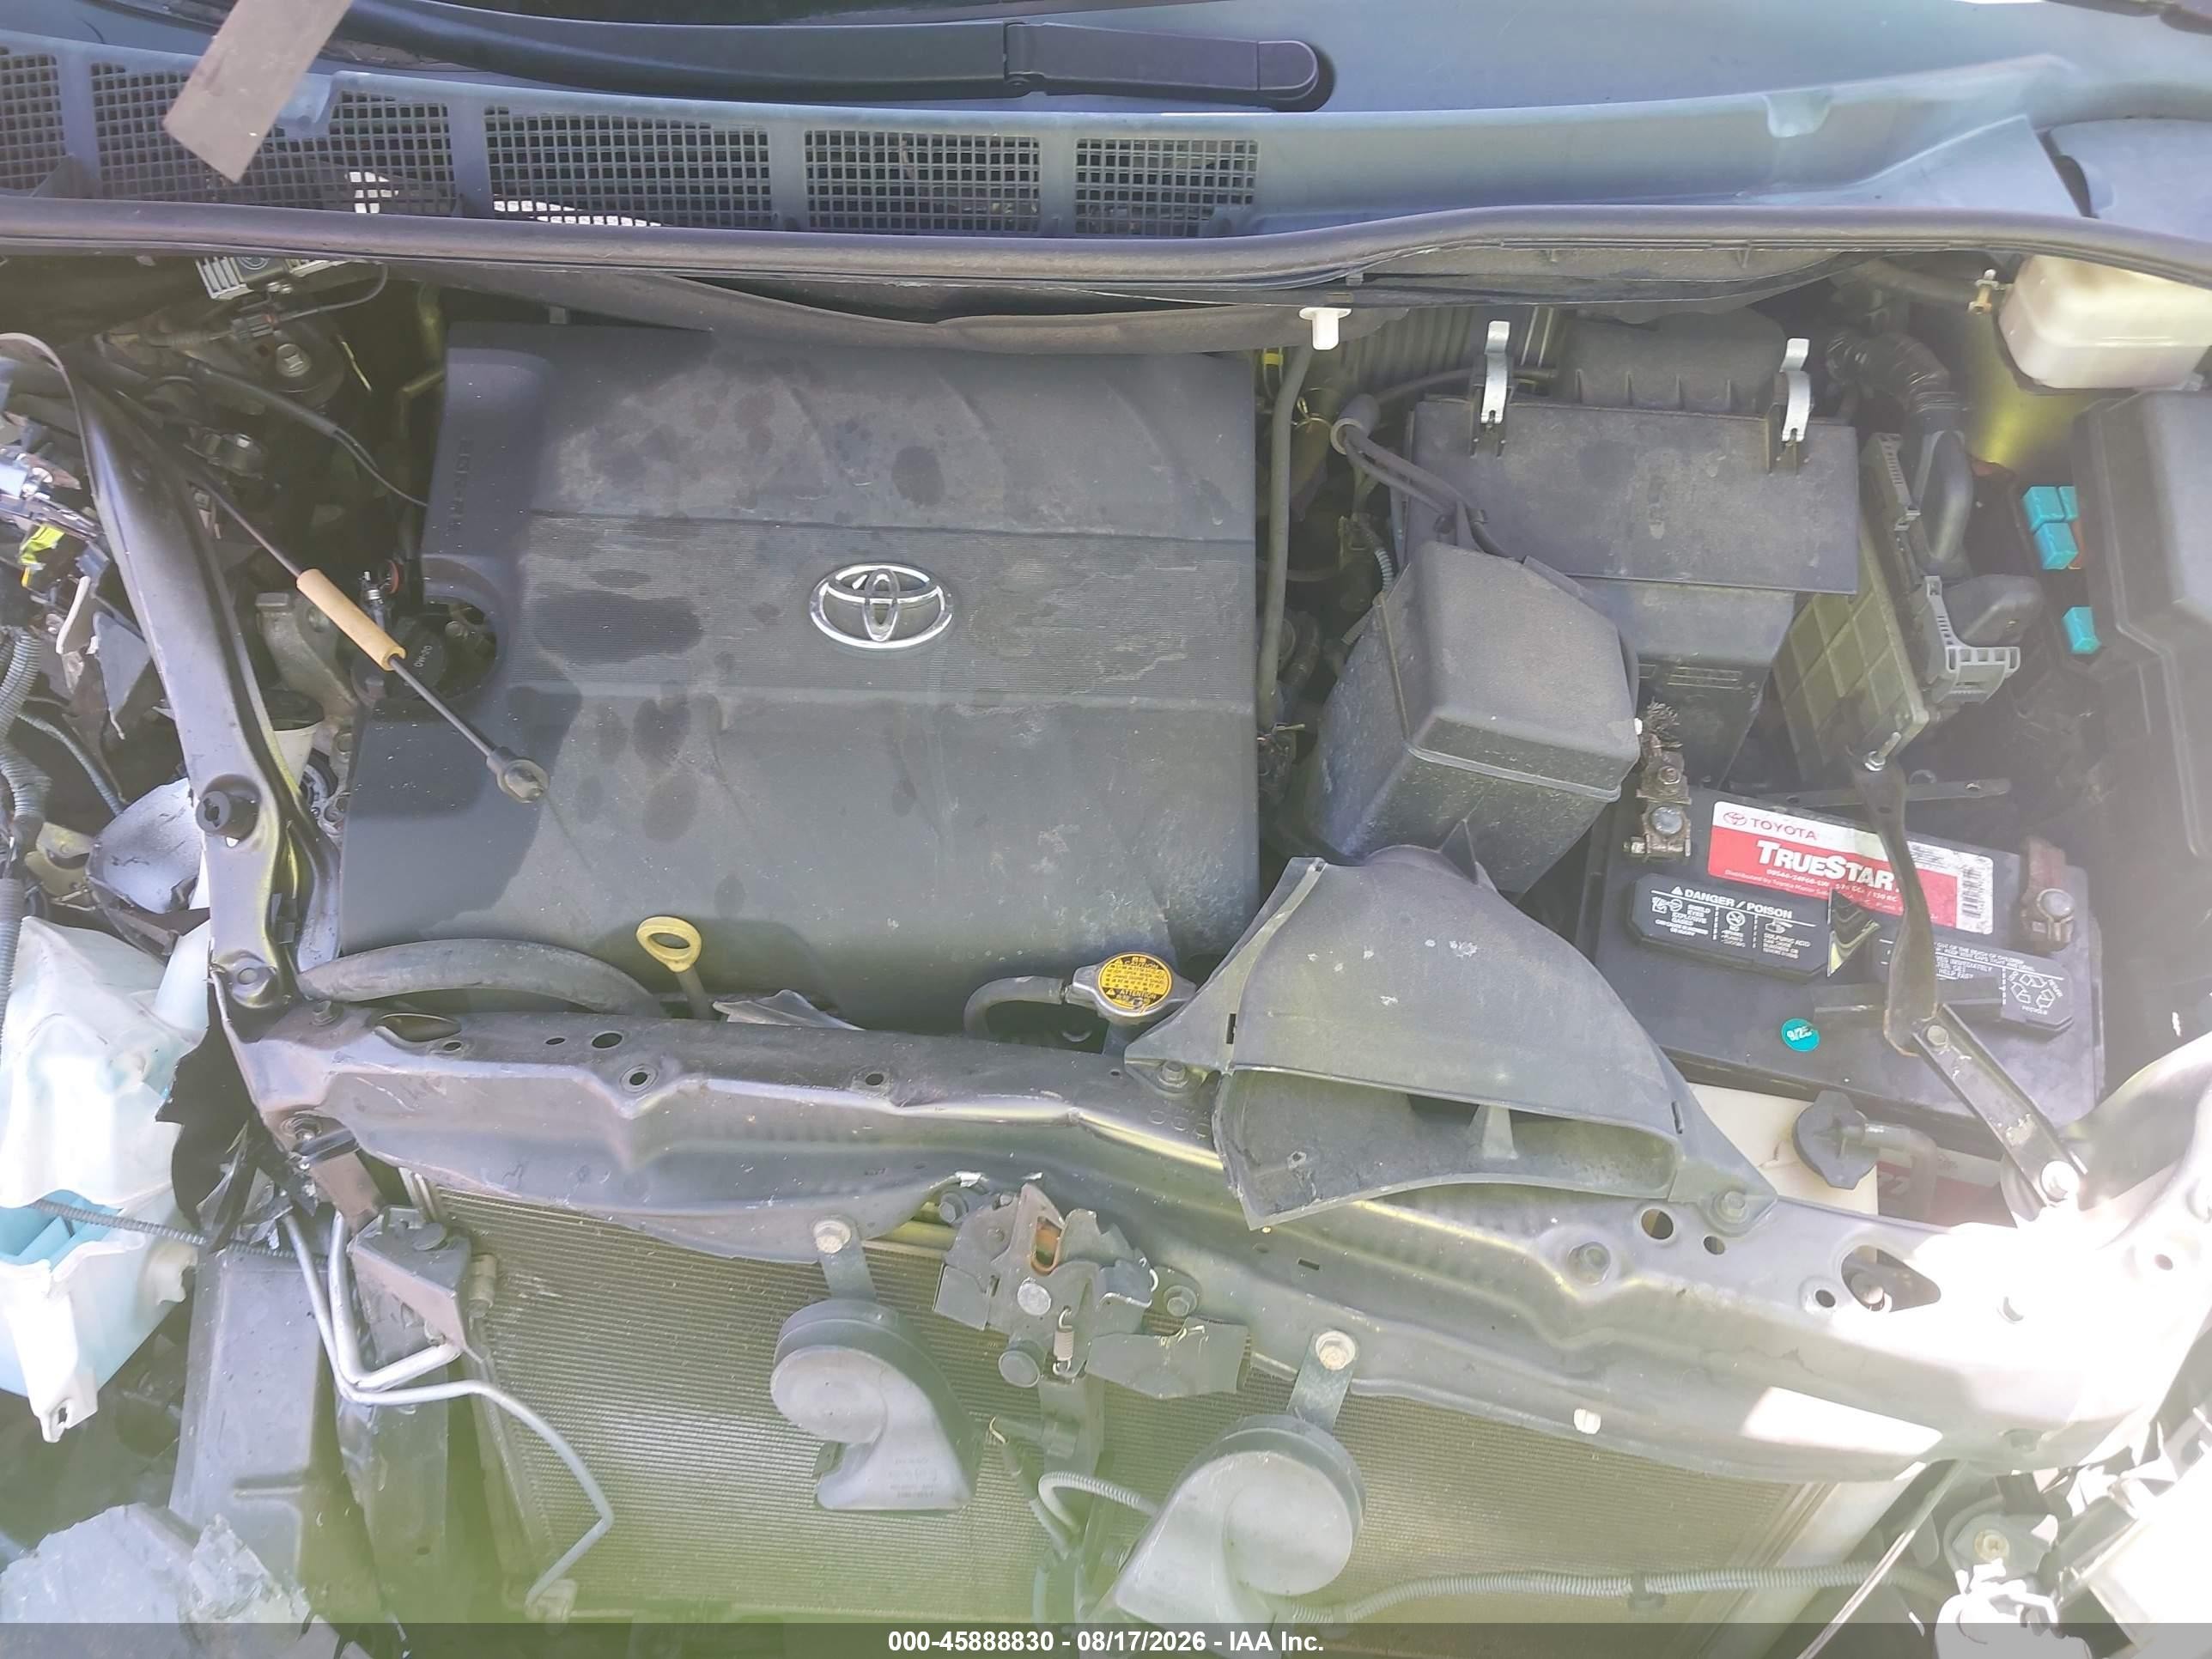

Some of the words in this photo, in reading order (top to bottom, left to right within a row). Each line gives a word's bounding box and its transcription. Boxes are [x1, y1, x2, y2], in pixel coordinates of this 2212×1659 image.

[1751, 817, 1818, 841] TOYOTA
[1757, 840, 1899, 892] TRUESTAR
[1685, 890, 1735, 908] DANGER
[1747, 902, 1793, 919] POISON
[1120, 989, 1157, 1000] ATTENTION
